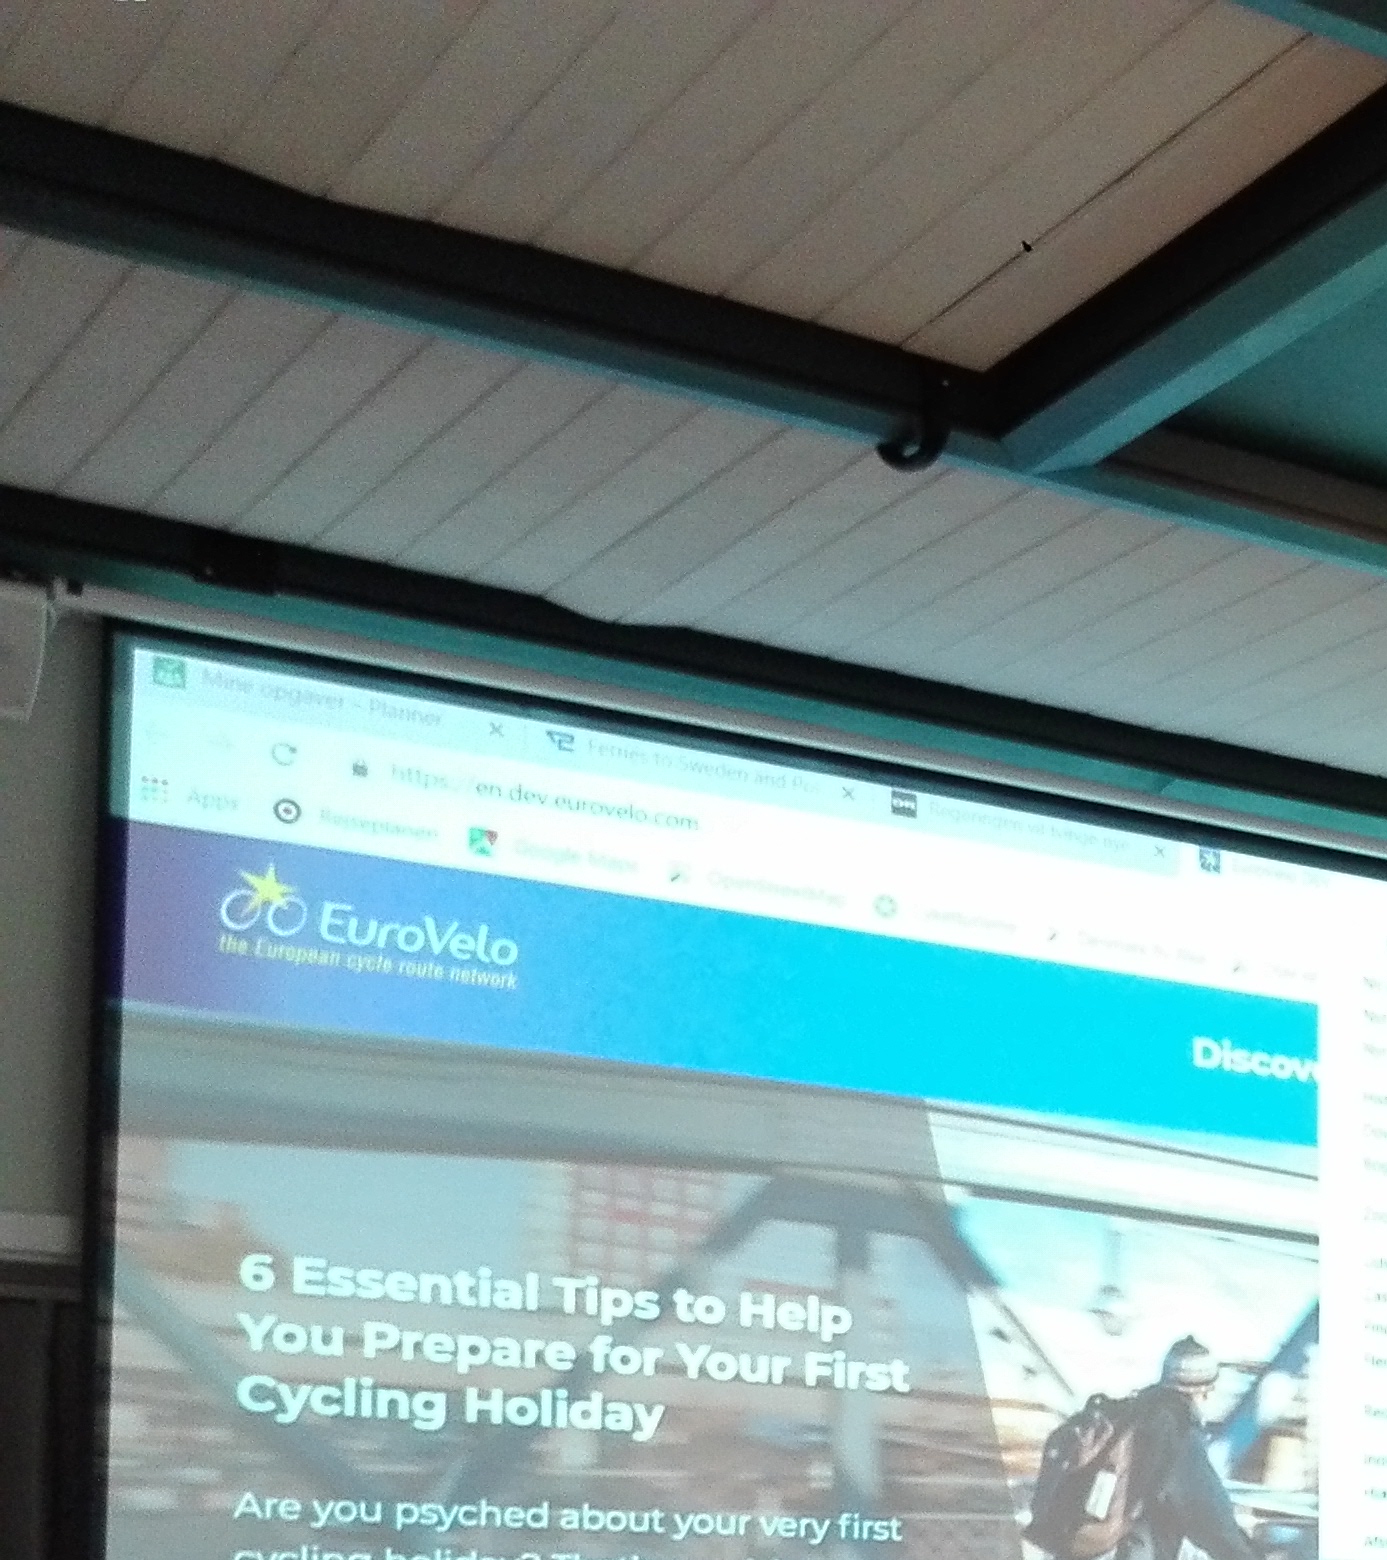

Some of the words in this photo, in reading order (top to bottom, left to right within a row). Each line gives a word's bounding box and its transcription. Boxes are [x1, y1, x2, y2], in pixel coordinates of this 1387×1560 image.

[218, 934, 248, 955] the
[254, 936, 341, 967] European
[346, 954, 393, 974] cycle
[399, 960, 445, 980] route
[450, 966, 519, 990] network
[320, 900, 519, 965] EuroVelo
[239, 1253, 276, 1293] 6
[292, 1256, 540, 1312] Essential
[552, 1274, 661, 1327] Tips
[673, 1287, 726, 1325] to
[739, 1291, 852, 1342] Help
[236, 1312, 345, 1357] You
[363, 1319, 577, 1376] Prepare
[589, 1334, 665, 1377] for
[675, 1341, 792, 1386] Your
[804, 1350, 910, 1393] First
[236, 1374, 447, 1432] Cycling
[466, 1386, 666, 1442] Holiday
[233, 1491, 302, 1521] Are
[310, 1499, 383, 1530] you
[395, 1498, 550, 1534] psyched
[559, 1503, 666, 1534] about
[672, 1511, 752, 1541] your
[759, 1515, 831, 1546] very
[838, 1513, 904, 1543] first
